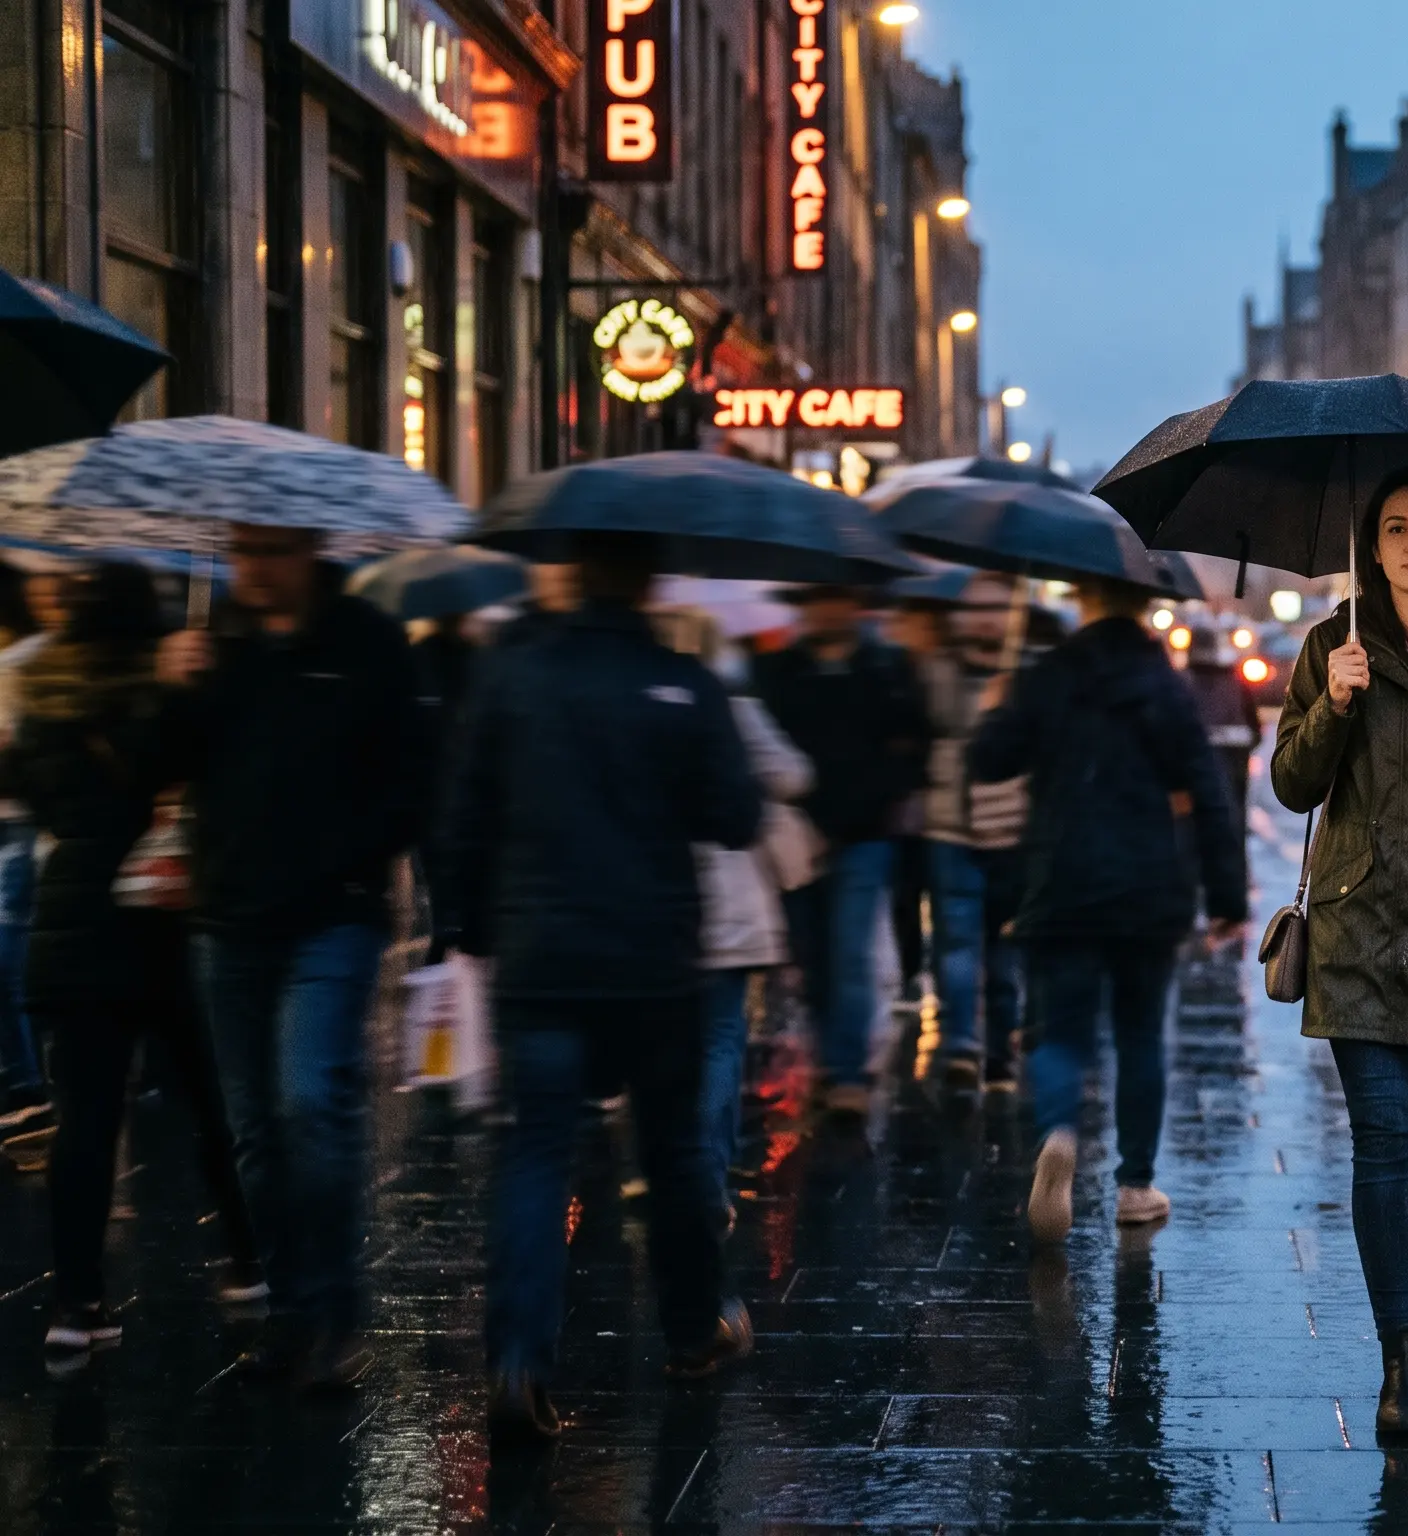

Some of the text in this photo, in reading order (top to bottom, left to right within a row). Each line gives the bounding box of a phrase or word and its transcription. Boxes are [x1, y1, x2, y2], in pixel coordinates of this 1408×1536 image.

[605, 0, 657, 162] PUB
[790, 127, 827, 270] CAFE
[799, 388, 904, 428] CAFE
